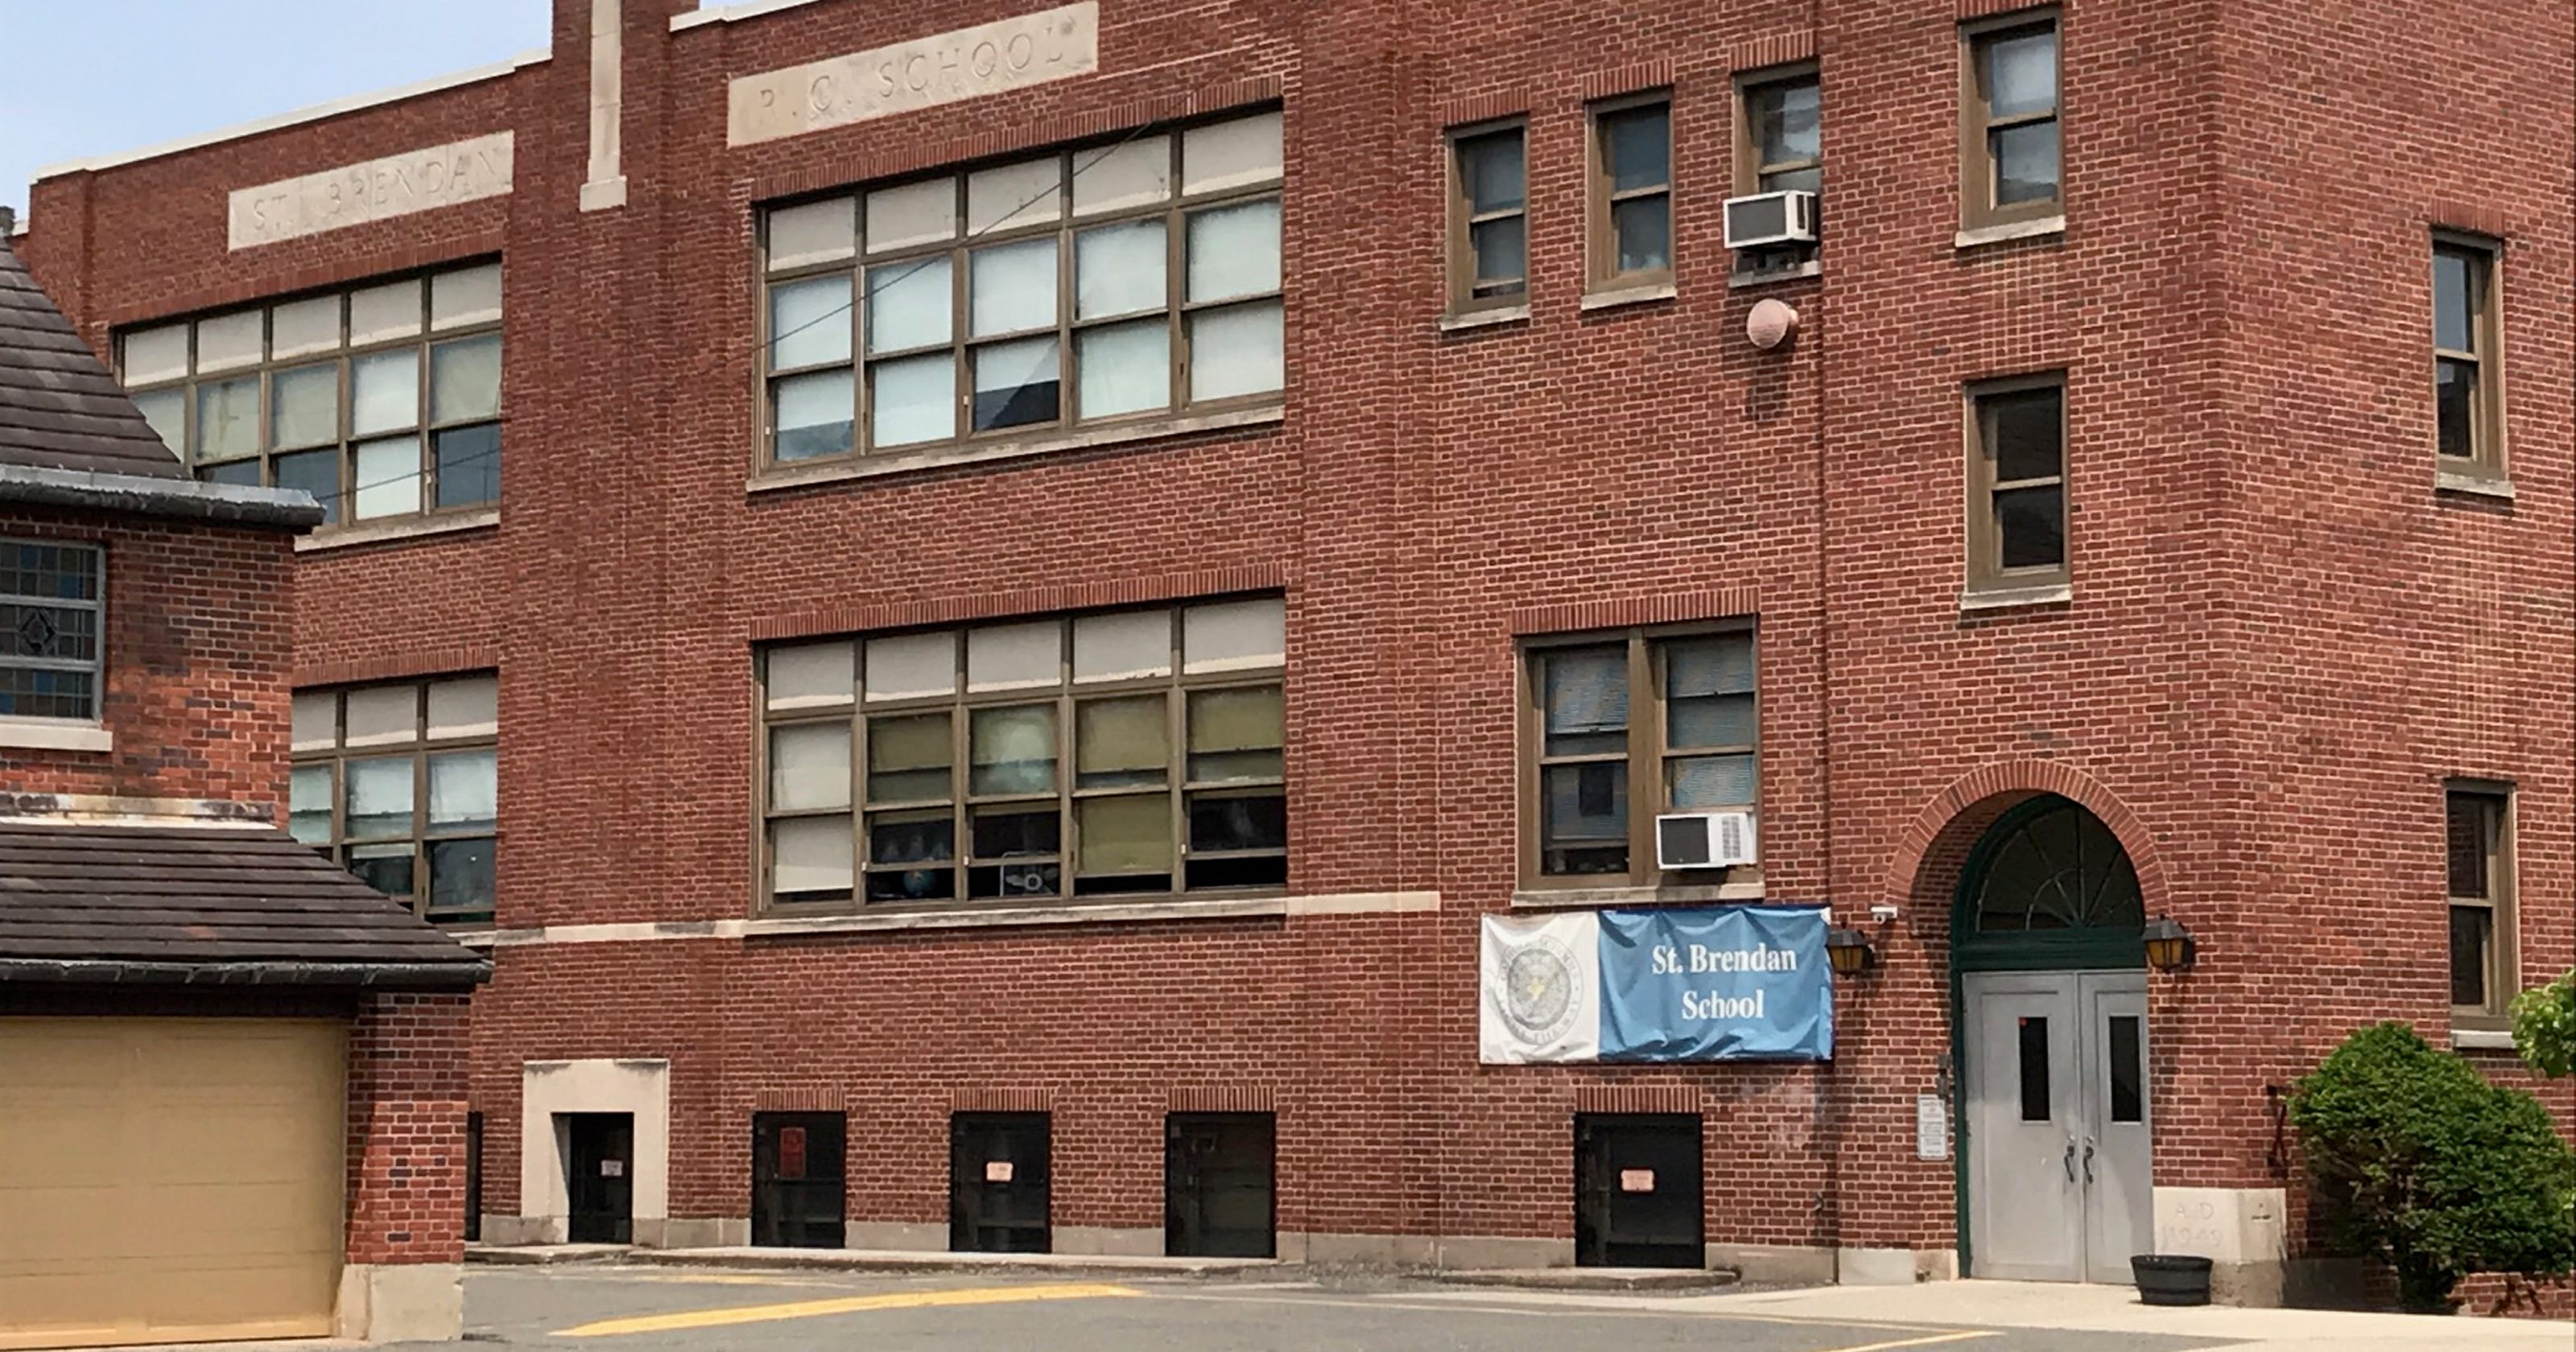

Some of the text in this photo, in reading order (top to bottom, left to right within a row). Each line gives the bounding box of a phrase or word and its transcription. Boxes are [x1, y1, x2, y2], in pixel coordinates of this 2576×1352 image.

[877, 25, 1064, 99] SCHOOL
[1651, 942, 1798, 975] St. Brendan
[1682, 989, 1765, 1020] School
